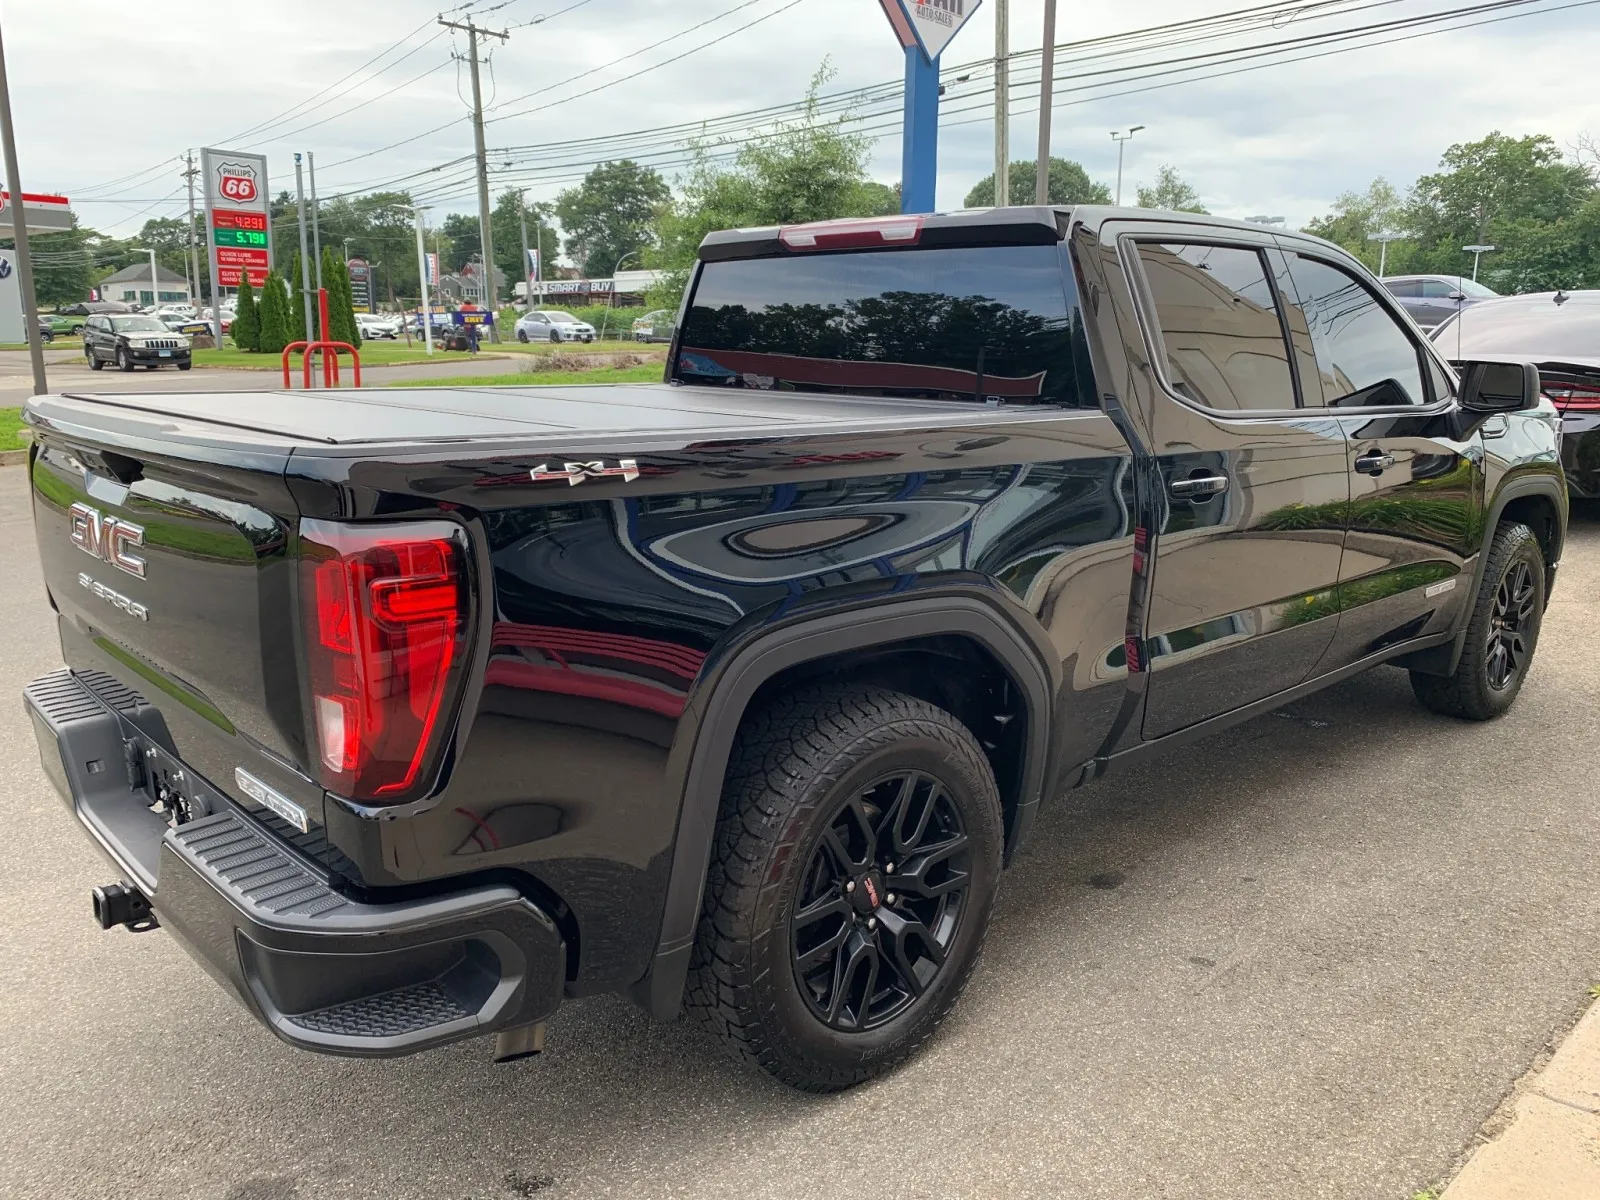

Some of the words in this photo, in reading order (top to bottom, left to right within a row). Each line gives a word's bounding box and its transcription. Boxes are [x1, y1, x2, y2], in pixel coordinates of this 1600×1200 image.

[916, 4, 933, 20] AUTO
[934, 10, 952, 26] SALES
[223, 168, 252, 177] PHILLIPS
[225, 179, 251, 196] 66
[548, 283, 581, 293] SMART
[591, 281, 611, 292] BUY
[68, 501, 148, 581] GMC
[78, 572, 149, 622] SIERRA
[863, 877, 879, 908] GMC
